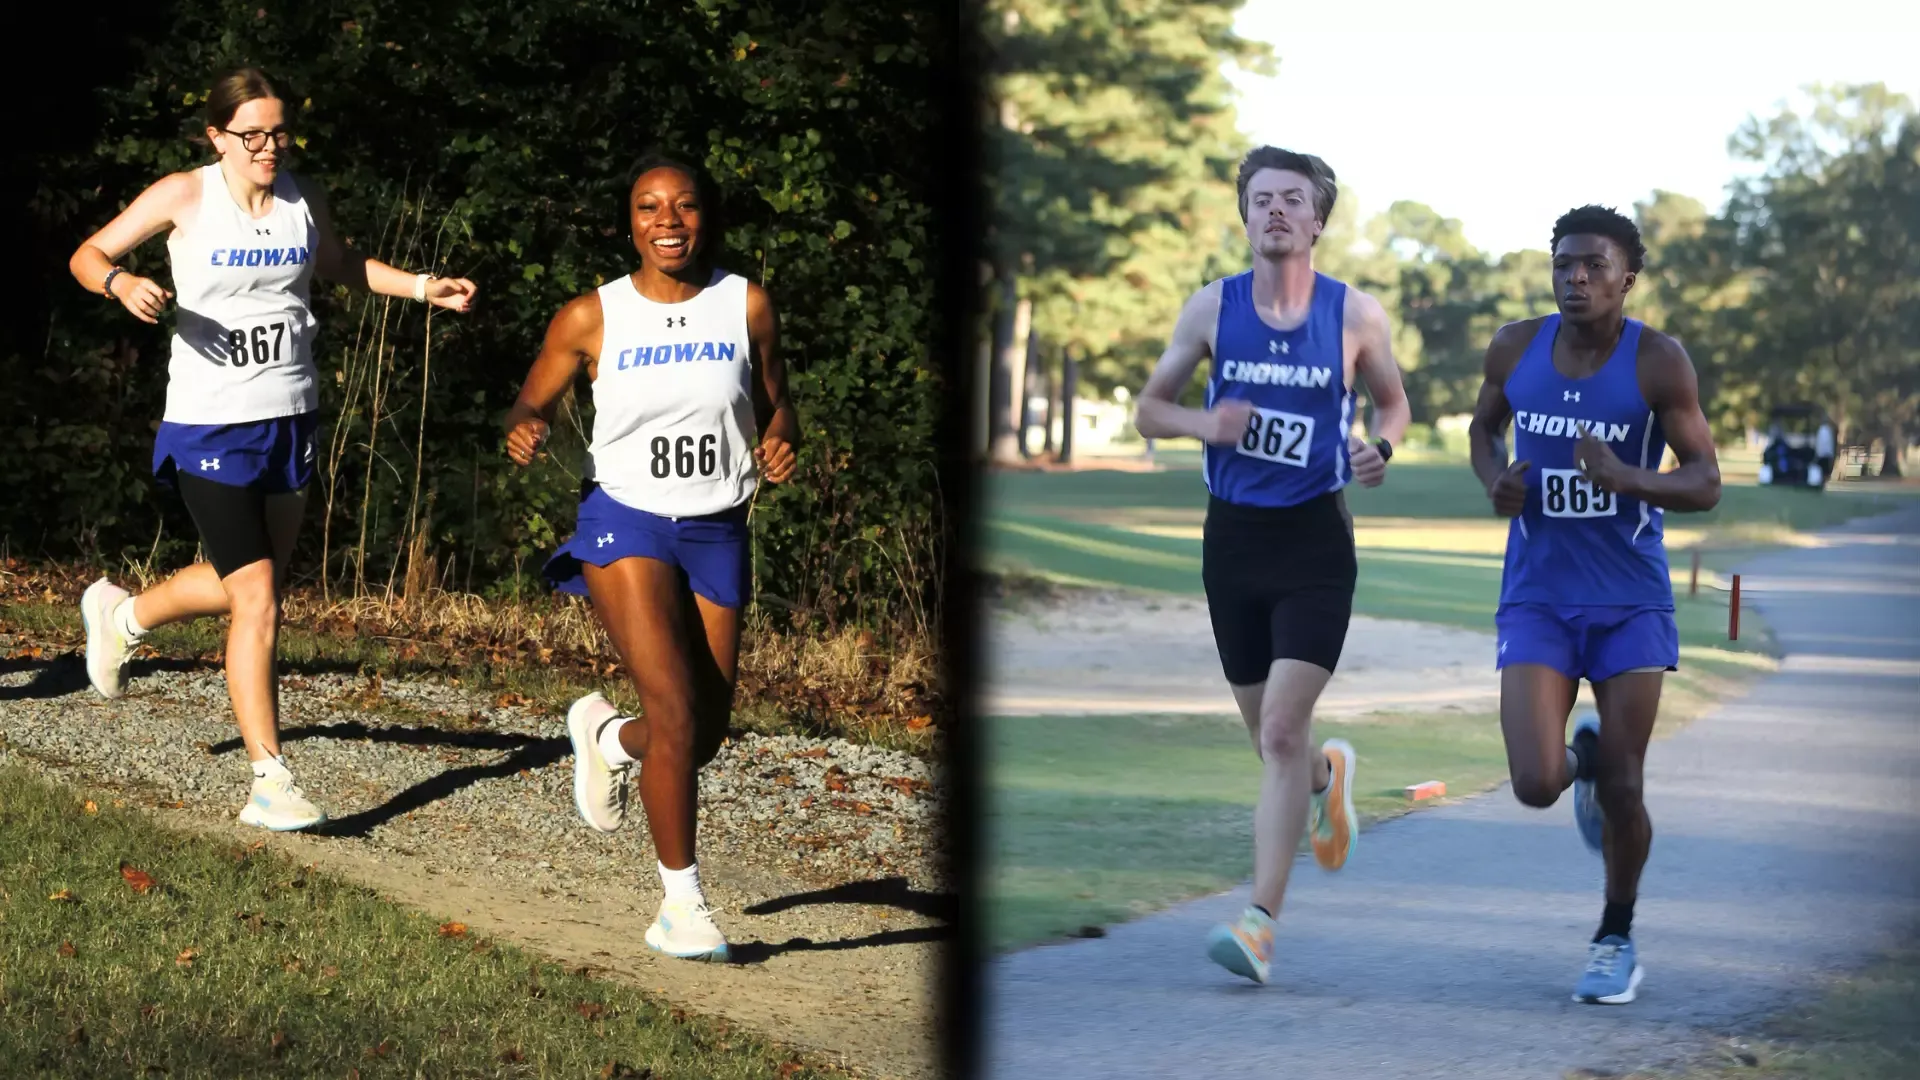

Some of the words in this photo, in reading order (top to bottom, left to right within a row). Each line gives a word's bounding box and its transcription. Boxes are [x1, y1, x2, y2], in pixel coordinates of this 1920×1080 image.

[211, 247, 311, 266] CHOWAN
[229, 322, 285, 367] 867
[617, 342, 735, 371] CHOWAN
[1222, 360, 1332, 388] CHOWAN
[1242, 412, 1307, 460] 862
[1516, 410, 1630, 442] CHOWAN
[650, 434, 716, 479] 866
